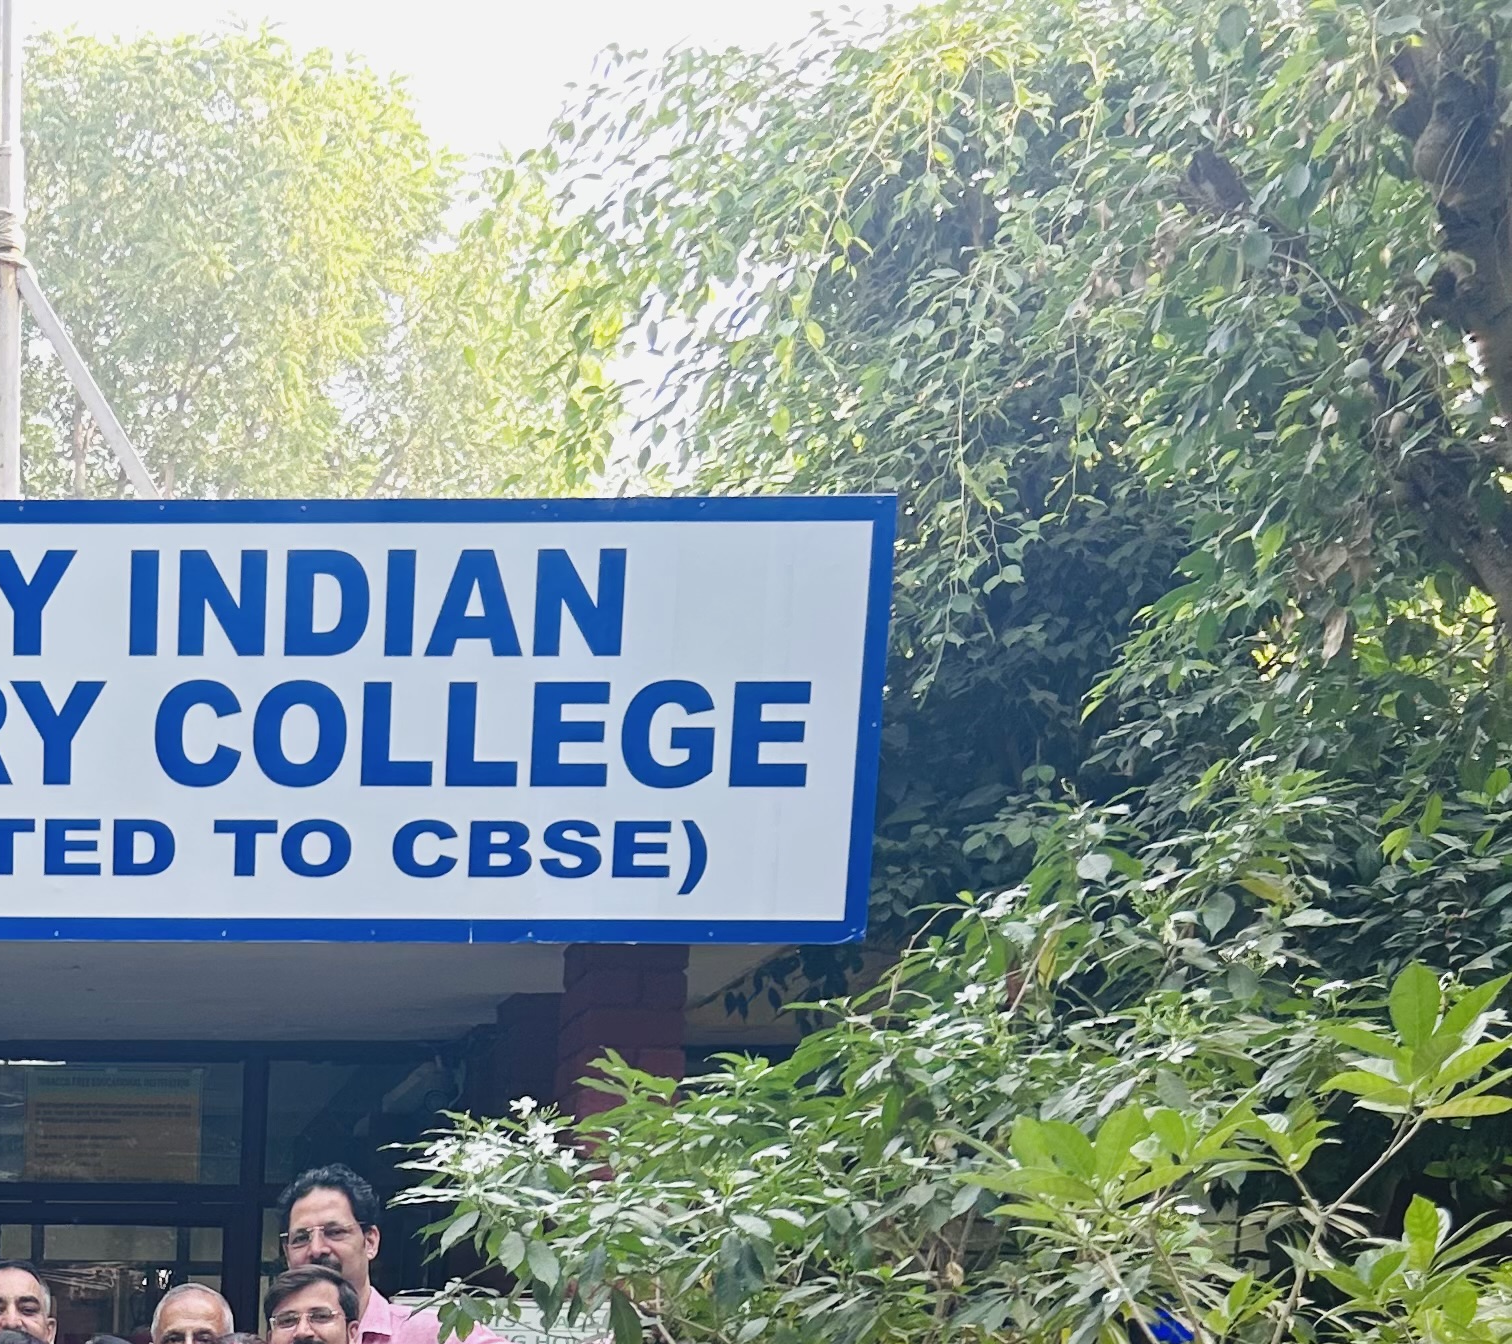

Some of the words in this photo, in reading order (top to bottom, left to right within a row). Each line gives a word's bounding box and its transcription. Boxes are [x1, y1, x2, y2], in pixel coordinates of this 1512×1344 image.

[129, 549, 626, 656] INDIAN
[155, 680, 811, 788] COLLEGE
[214, 819, 351, 877] TO
[393, 820, 707, 894] CBSE)
